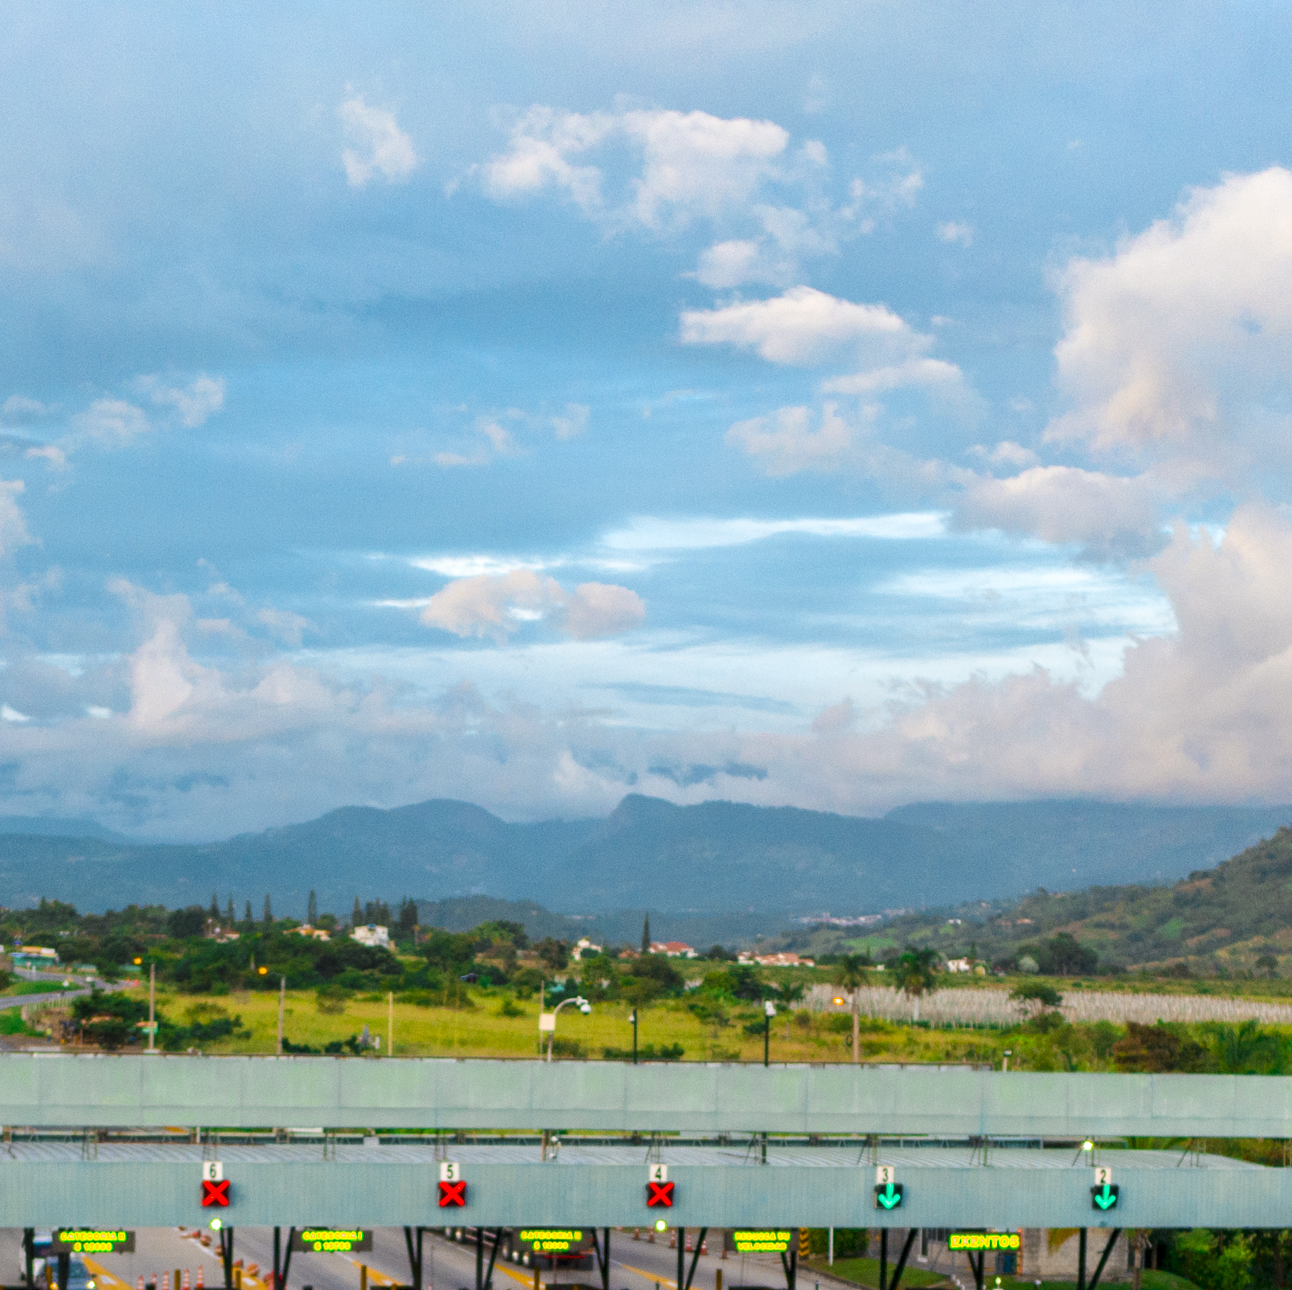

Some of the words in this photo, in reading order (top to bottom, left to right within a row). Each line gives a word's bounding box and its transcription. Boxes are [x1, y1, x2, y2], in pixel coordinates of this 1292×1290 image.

[209, 1163, 217, 1179] 6
[446, 1164, 453, 1179] 5
[654, 1166, 662, 1180] 4
[882, 1167, 889, 1183] 3
[1099, 1169, 1107, 1184] 2
[59, 1231, 117, 1242] CATEGORIA
[301, 1230, 357, 1242] CATEGORIA
[520, 1230, 573, 1241] CATEGORIA
[949, 1234, 1020, 1249] EXENTOS
[736, 1241, 788, 1252] VELOCIDAD
